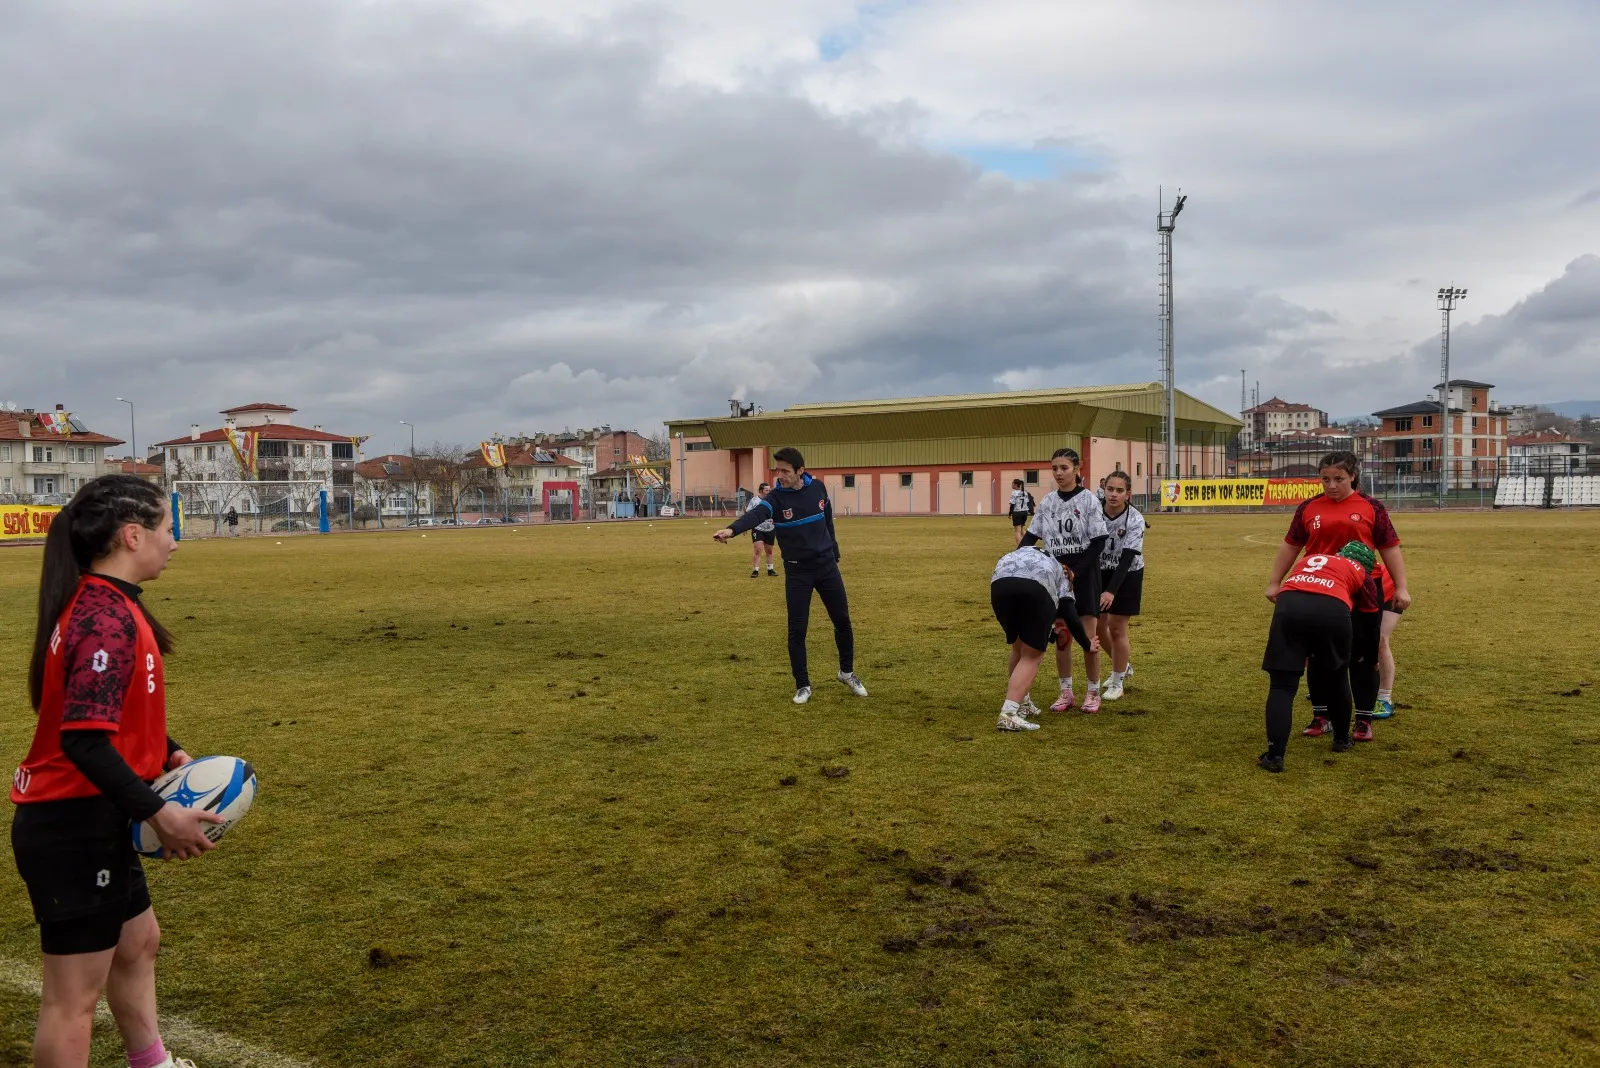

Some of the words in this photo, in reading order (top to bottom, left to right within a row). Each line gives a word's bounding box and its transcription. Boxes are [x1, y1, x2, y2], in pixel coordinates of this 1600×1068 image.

[1184, 486, 1200, 500] SEN
[1202, 484, 1216, 500] BEN
[1218, 484, 1234, 500] YOK
[1236, 484, 1264, 500] SADECE
[1020, 498, 1024, 510] 7
[1056, 518, 1074, 534] 10
[1312, 520, 1320, 530] 15
[1302, 556, 1328, 572] 9
[1286, 574, 1335, 588] AŞKÖPRÜ
[147, 674, 156, 694] 6
